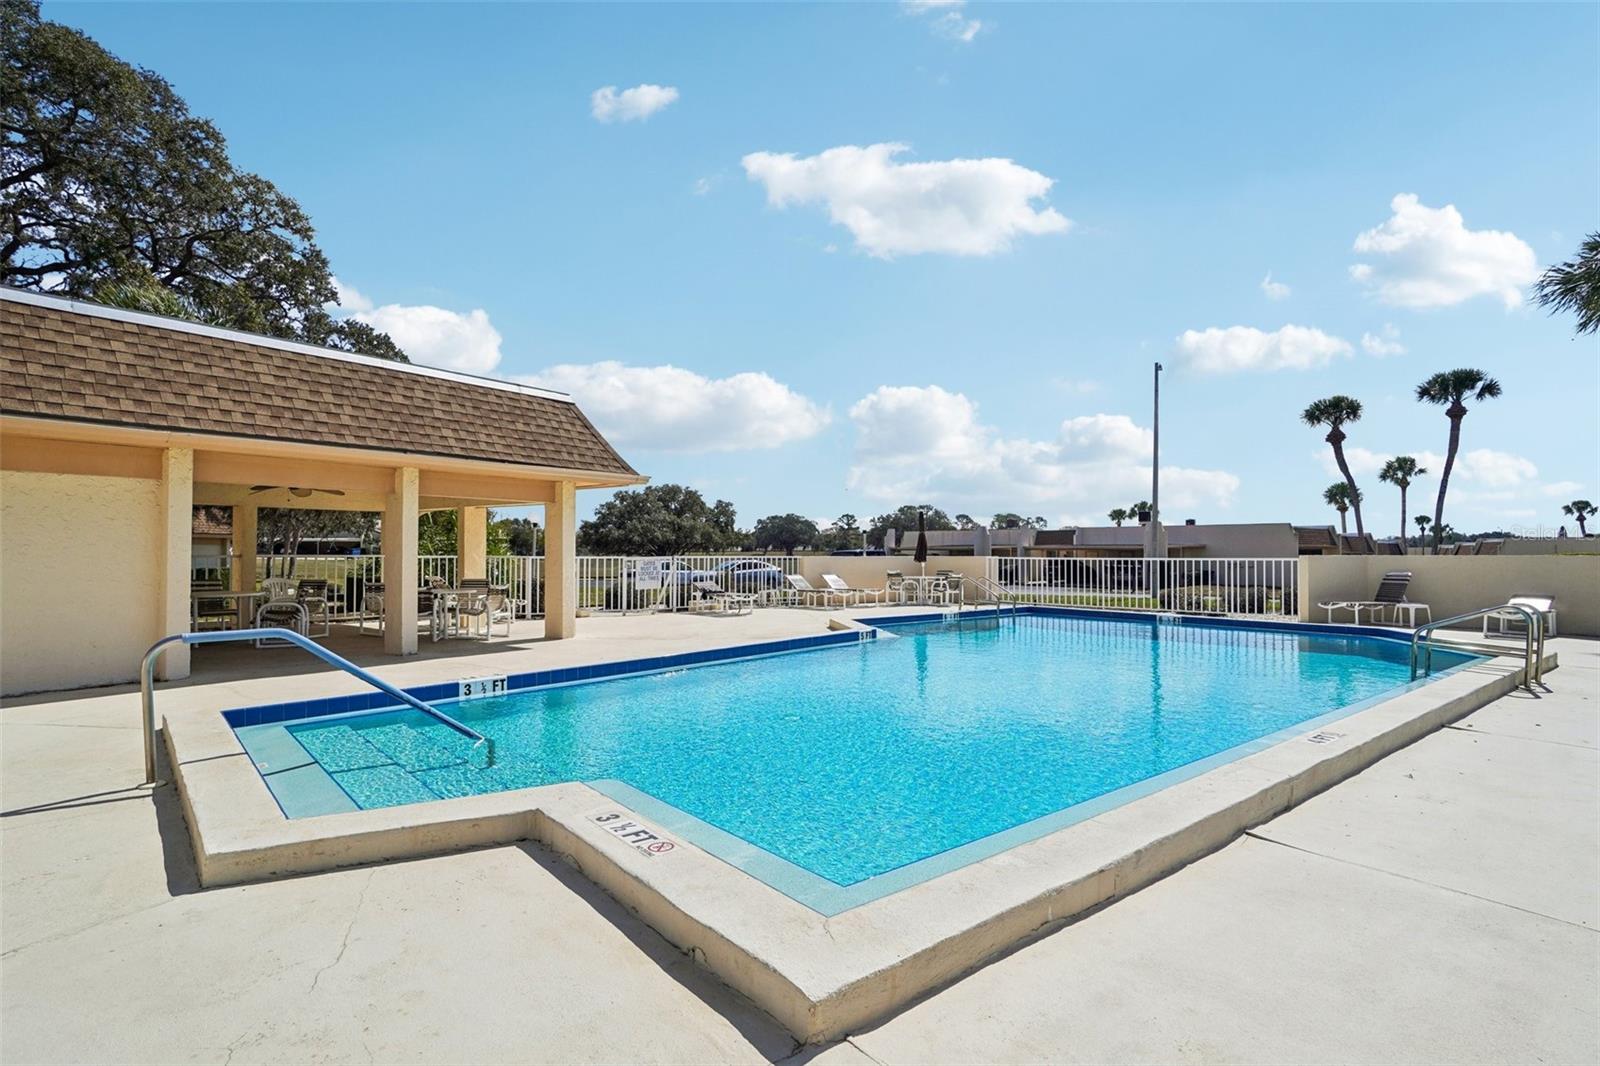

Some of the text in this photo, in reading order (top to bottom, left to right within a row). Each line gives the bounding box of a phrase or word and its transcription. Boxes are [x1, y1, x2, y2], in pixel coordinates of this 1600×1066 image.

[464, 683, 472, 696] 3
[492, 678, 506, 692] FT
[595, 813, 621, 823] 3
[621, 829, 659, 844] FT
